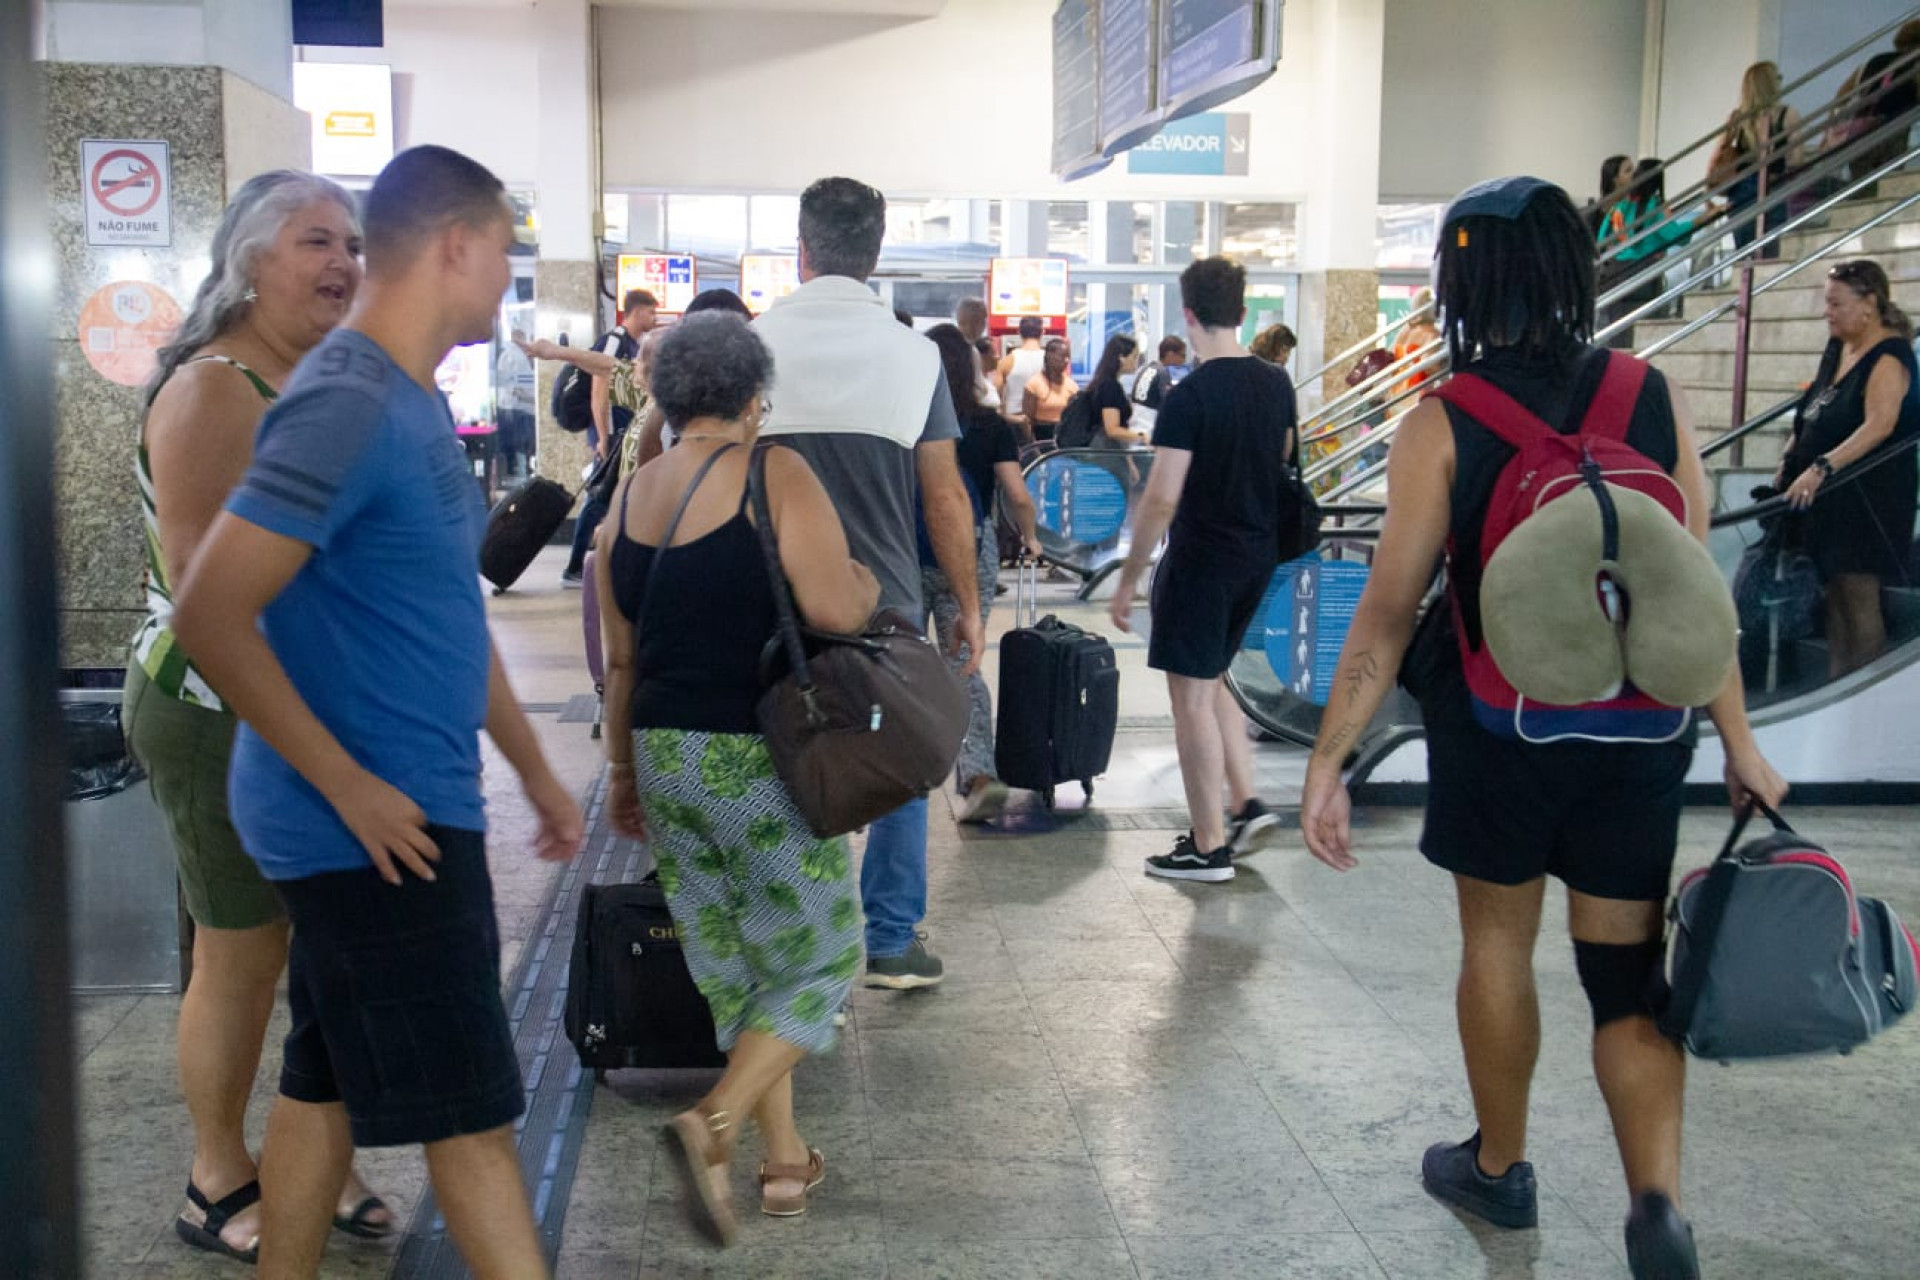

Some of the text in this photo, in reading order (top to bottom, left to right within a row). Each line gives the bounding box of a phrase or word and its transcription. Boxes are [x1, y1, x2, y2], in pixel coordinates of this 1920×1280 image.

[1133, 134, 1220, 152] LEVADOR
[98, 219, 160, 232] NÃO FUME
